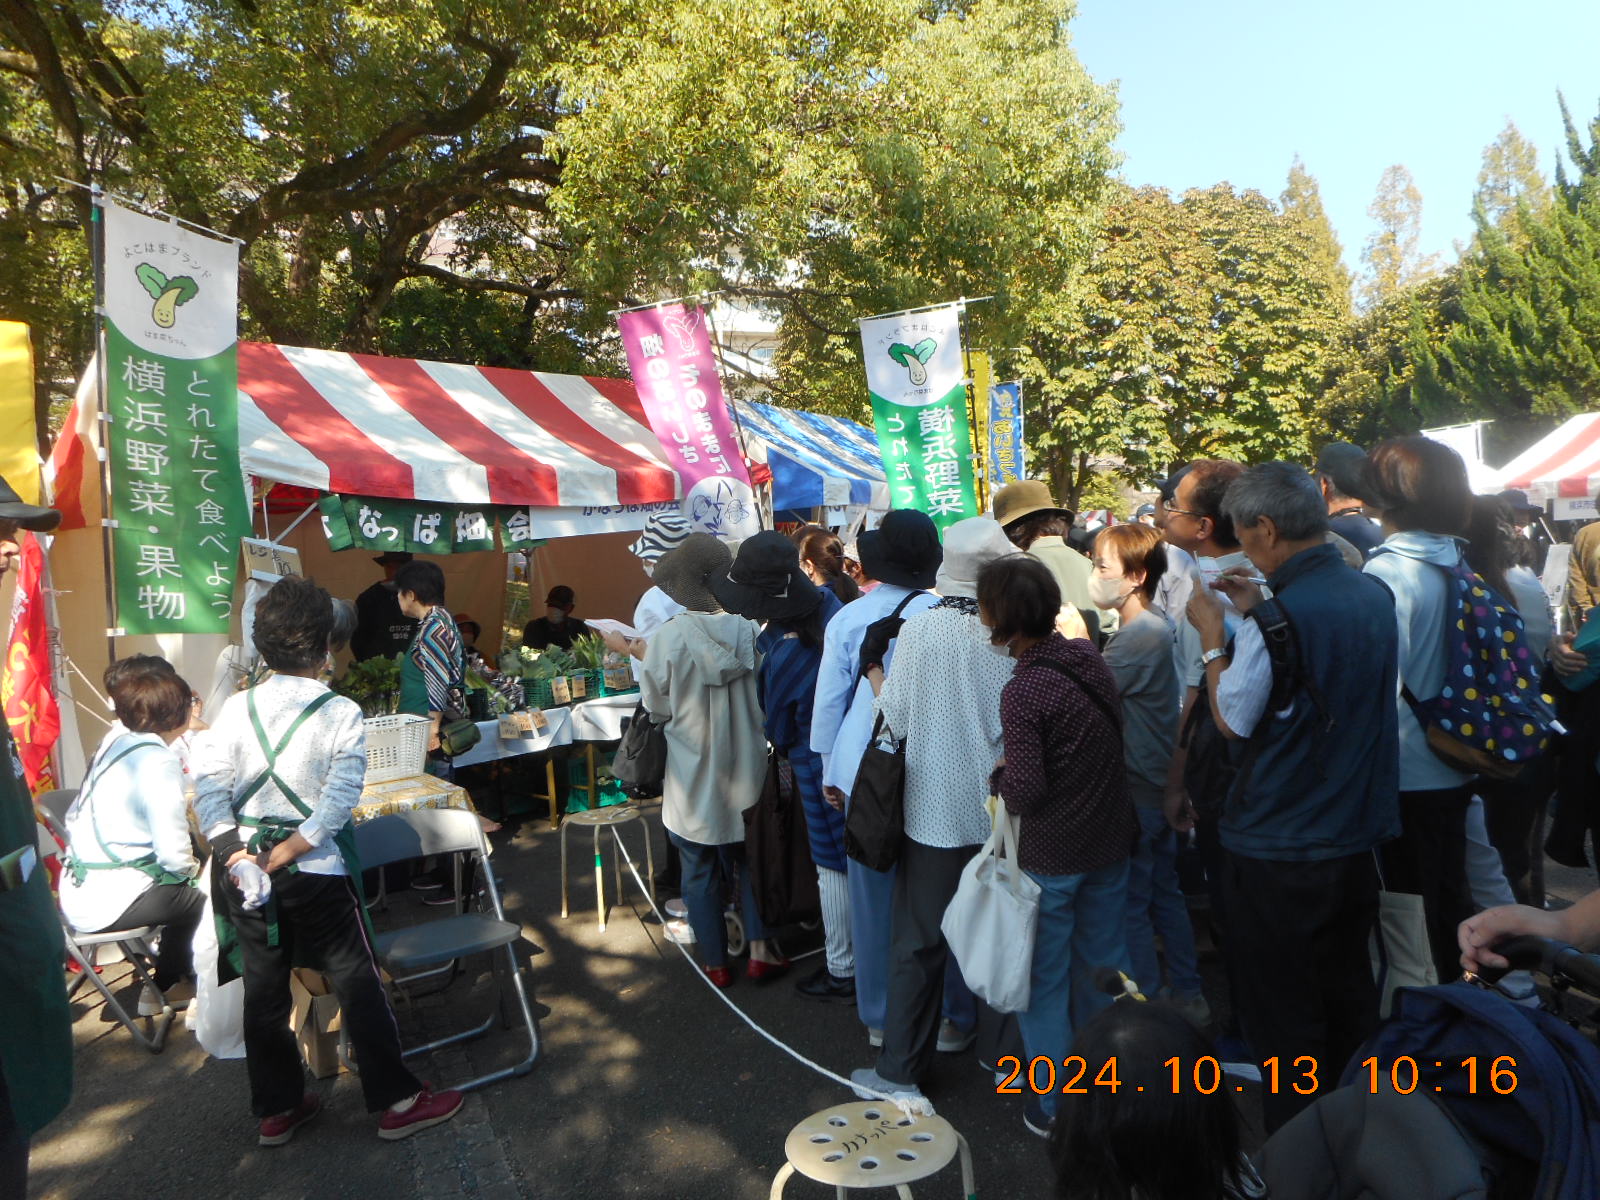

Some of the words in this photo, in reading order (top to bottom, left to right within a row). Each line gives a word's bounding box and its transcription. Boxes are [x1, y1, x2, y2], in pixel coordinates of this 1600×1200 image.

[122, 355, 186, 621] 横浜野菜・果物
[186, 370, 233, 619] とれたて食べよう
